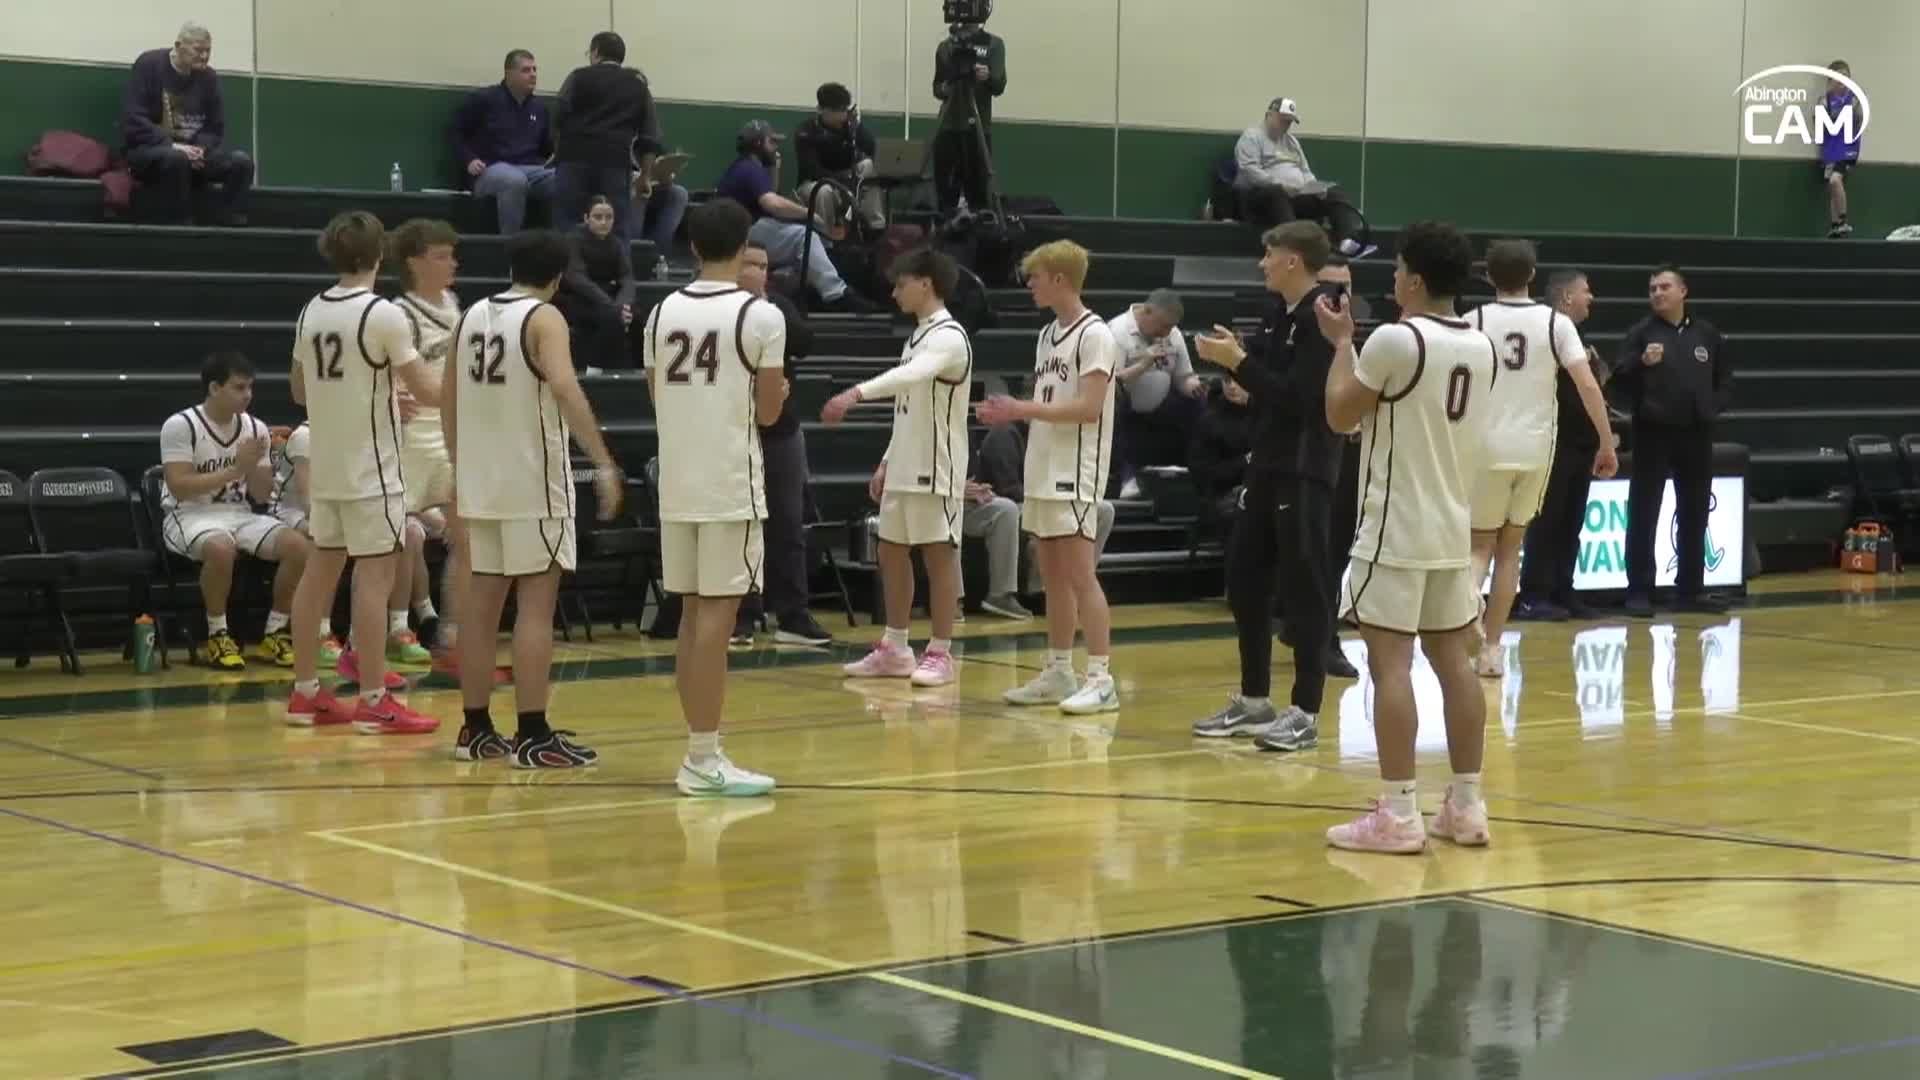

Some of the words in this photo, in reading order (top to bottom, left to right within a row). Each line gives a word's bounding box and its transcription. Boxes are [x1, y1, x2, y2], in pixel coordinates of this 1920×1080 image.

[312, 331, 345, 380] 12
[468, 331, 507, 385] 32
[665, 330, 720, 386] 24
[1503, 331, 1528, 372] 3
[1446, 364, 1473, 423] 0
